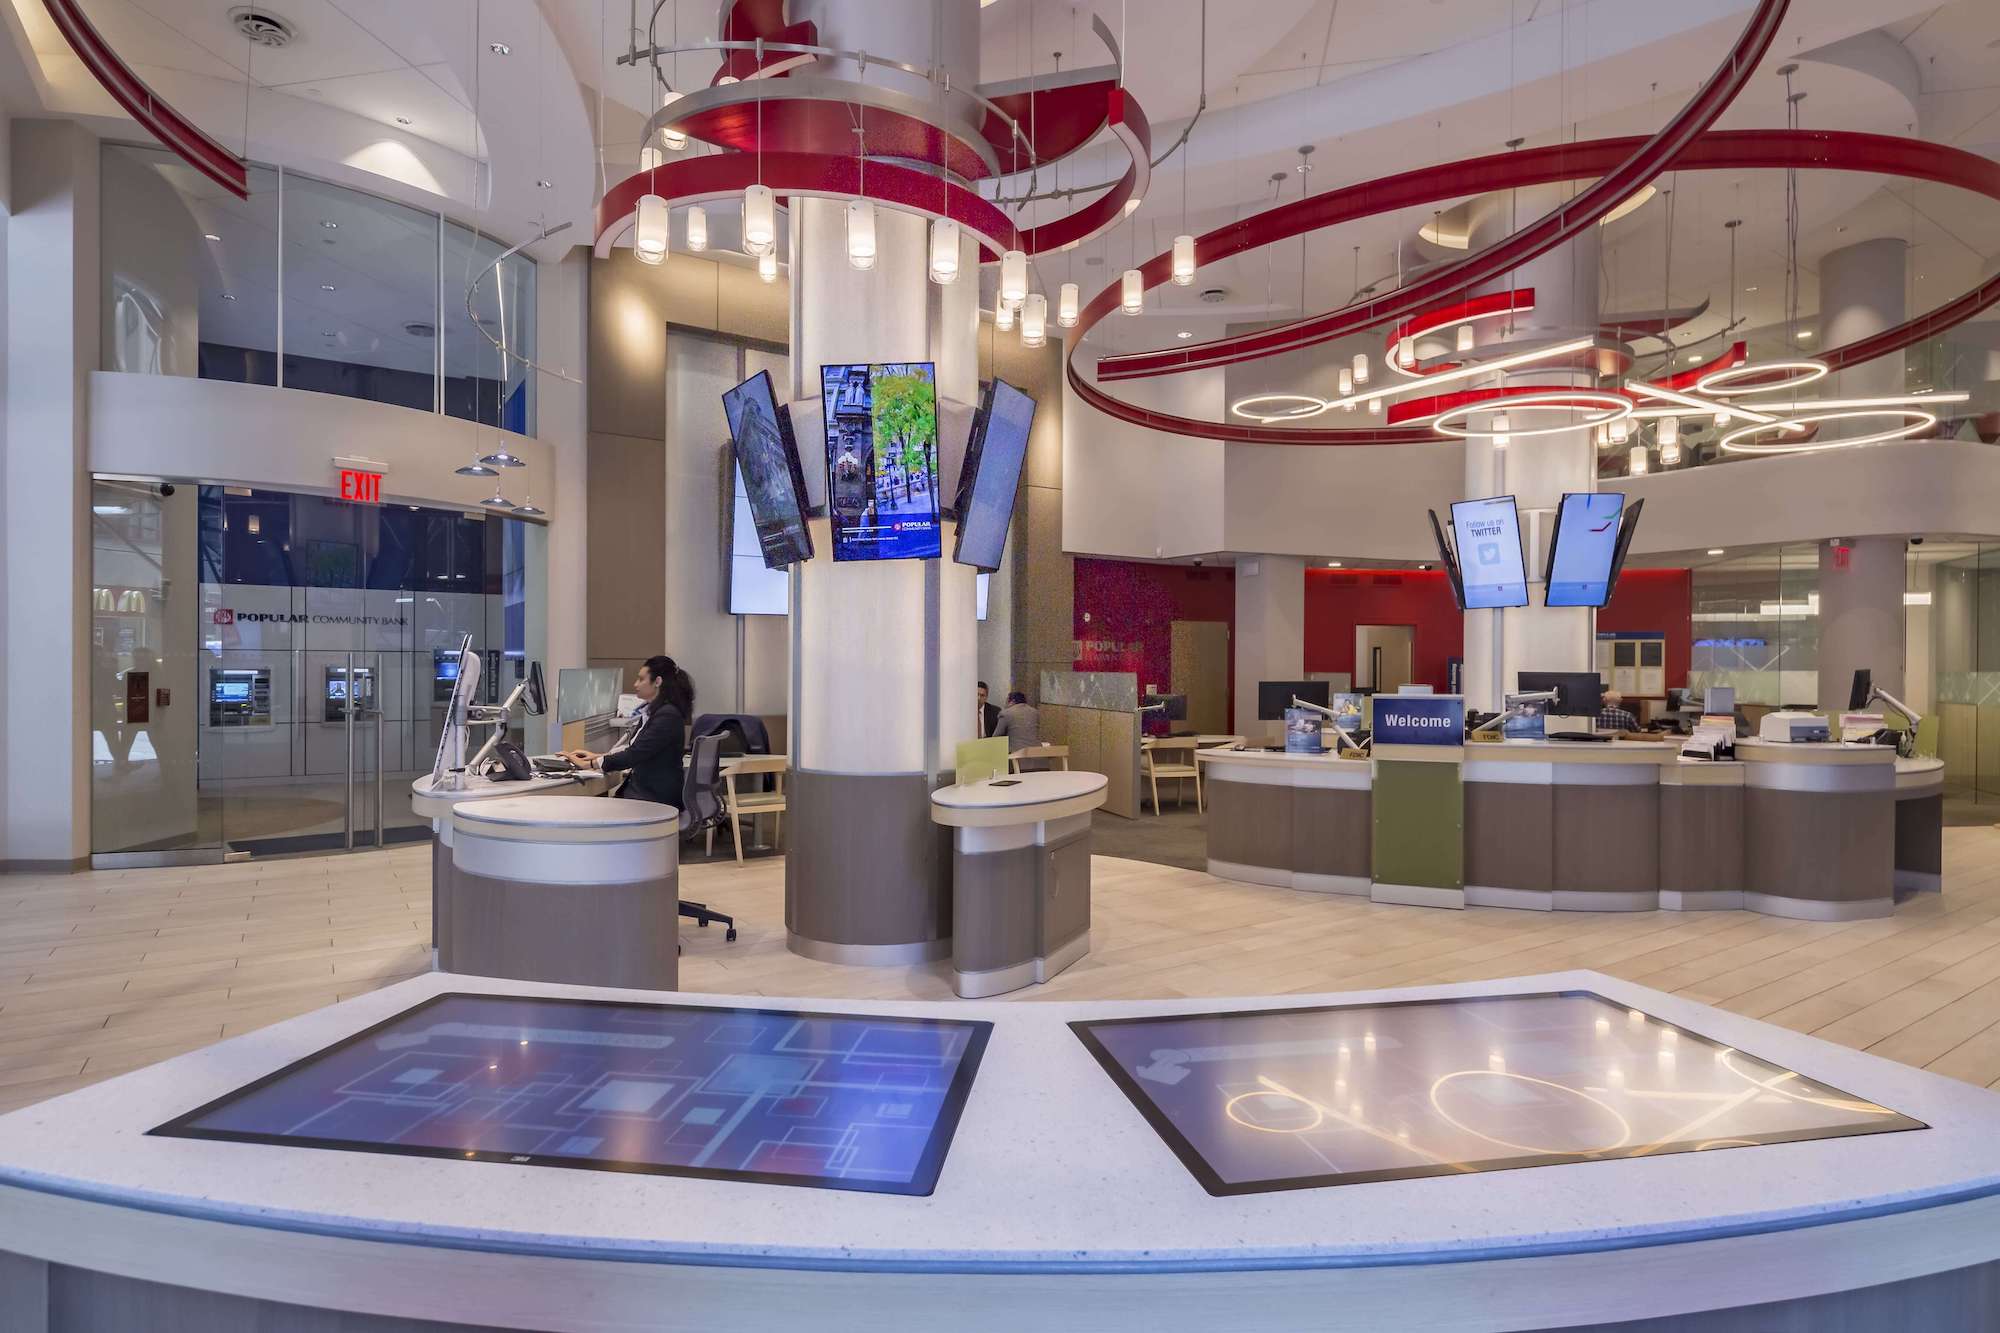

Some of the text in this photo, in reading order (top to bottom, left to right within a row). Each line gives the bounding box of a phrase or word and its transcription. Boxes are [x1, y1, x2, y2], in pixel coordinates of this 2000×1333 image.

[340, 469, 384, 505] EXIT
[1471, 527, 1501, 537] TWITTER
[237, 612, 408, 627] POPULAR COMMUNITY BANK
[1385, 714, 1451, 727] Welcome
